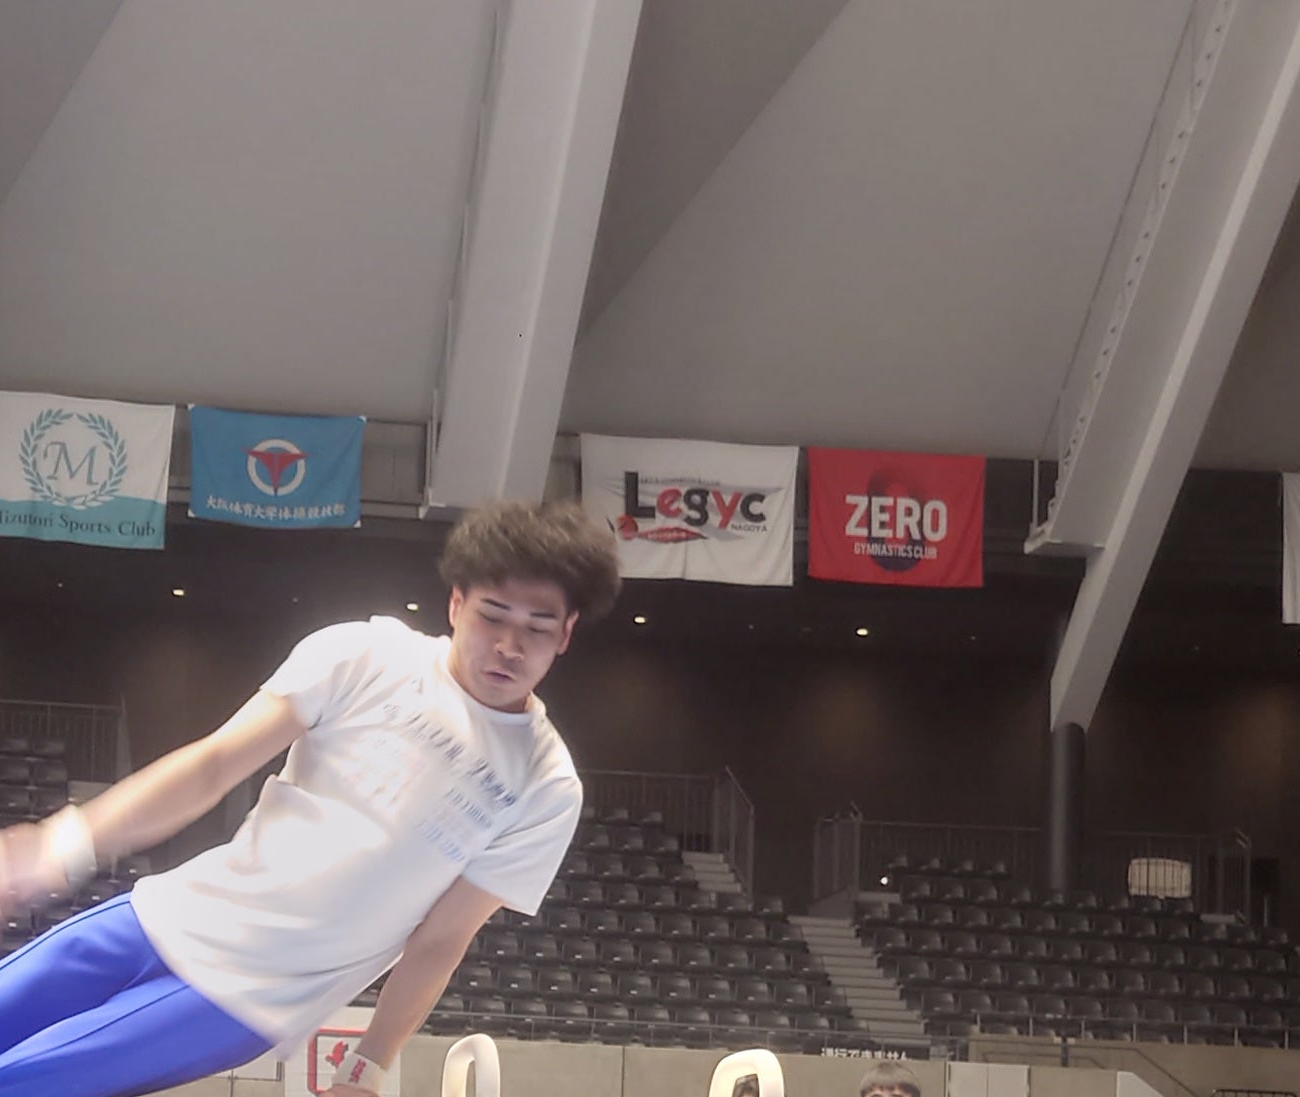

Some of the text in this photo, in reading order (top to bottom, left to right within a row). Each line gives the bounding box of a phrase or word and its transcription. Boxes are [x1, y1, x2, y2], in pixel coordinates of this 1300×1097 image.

[44, 441, 100, 486] M
[624, 471, 767, 530] Legyc
[58, 515, 112, 534] Sports
[118, 520, 156, 537] Club
[731, 523, 768, 532] NAGOYA
[845, 494, 947, 542] ZERO
[854, 542, 937, 559] GYMNASTICS CLUB
